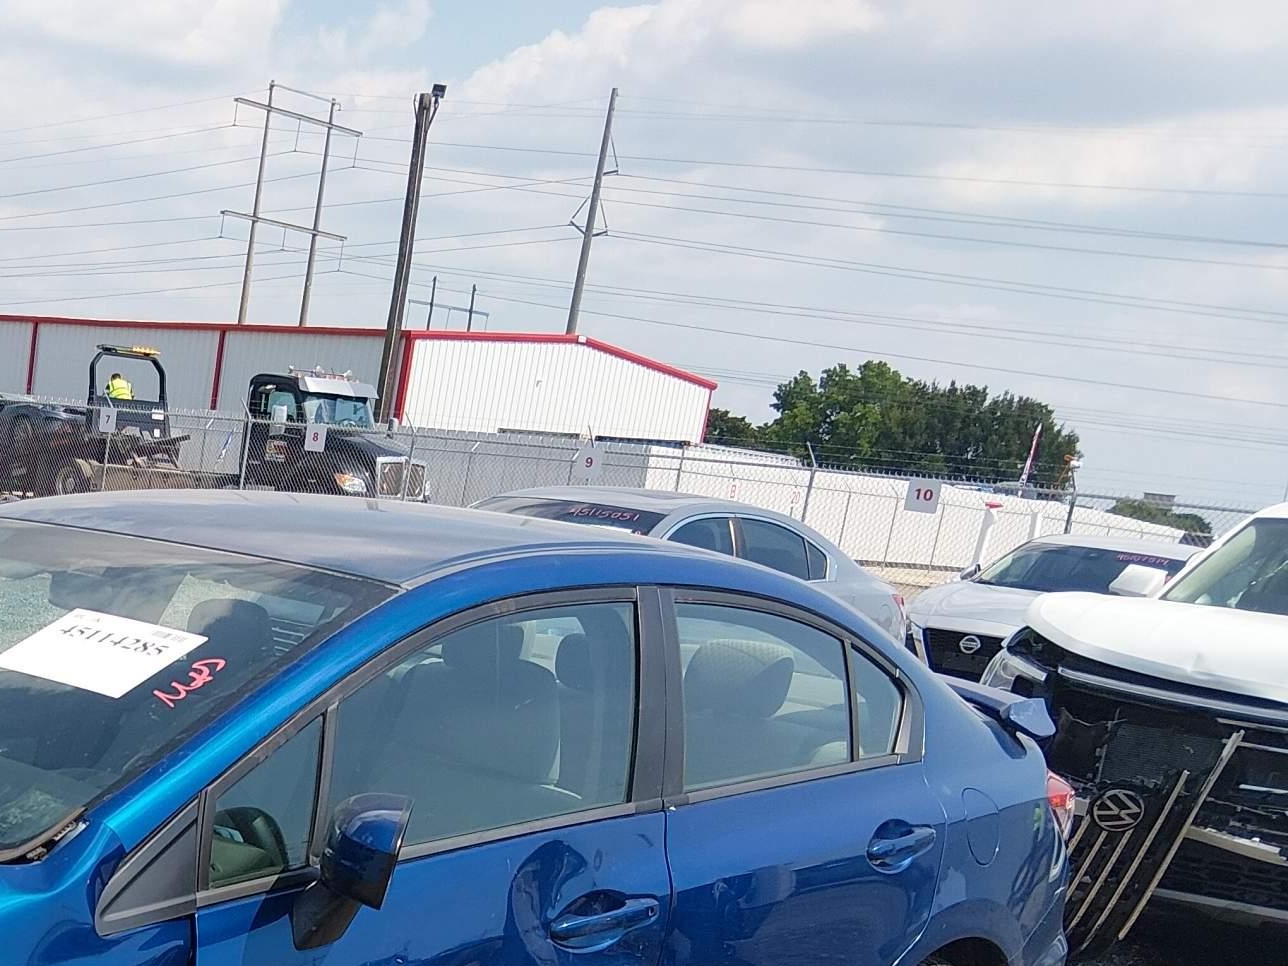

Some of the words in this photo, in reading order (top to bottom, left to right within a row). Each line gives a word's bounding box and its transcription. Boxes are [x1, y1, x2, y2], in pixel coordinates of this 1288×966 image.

[104, 414, 112, 425] 7
[312, 431, 319, 442] 8
[584, 456, 593, 469] 9
[915, 488, 934, 502] 10
[59, 624, 170, 656] 45114285
